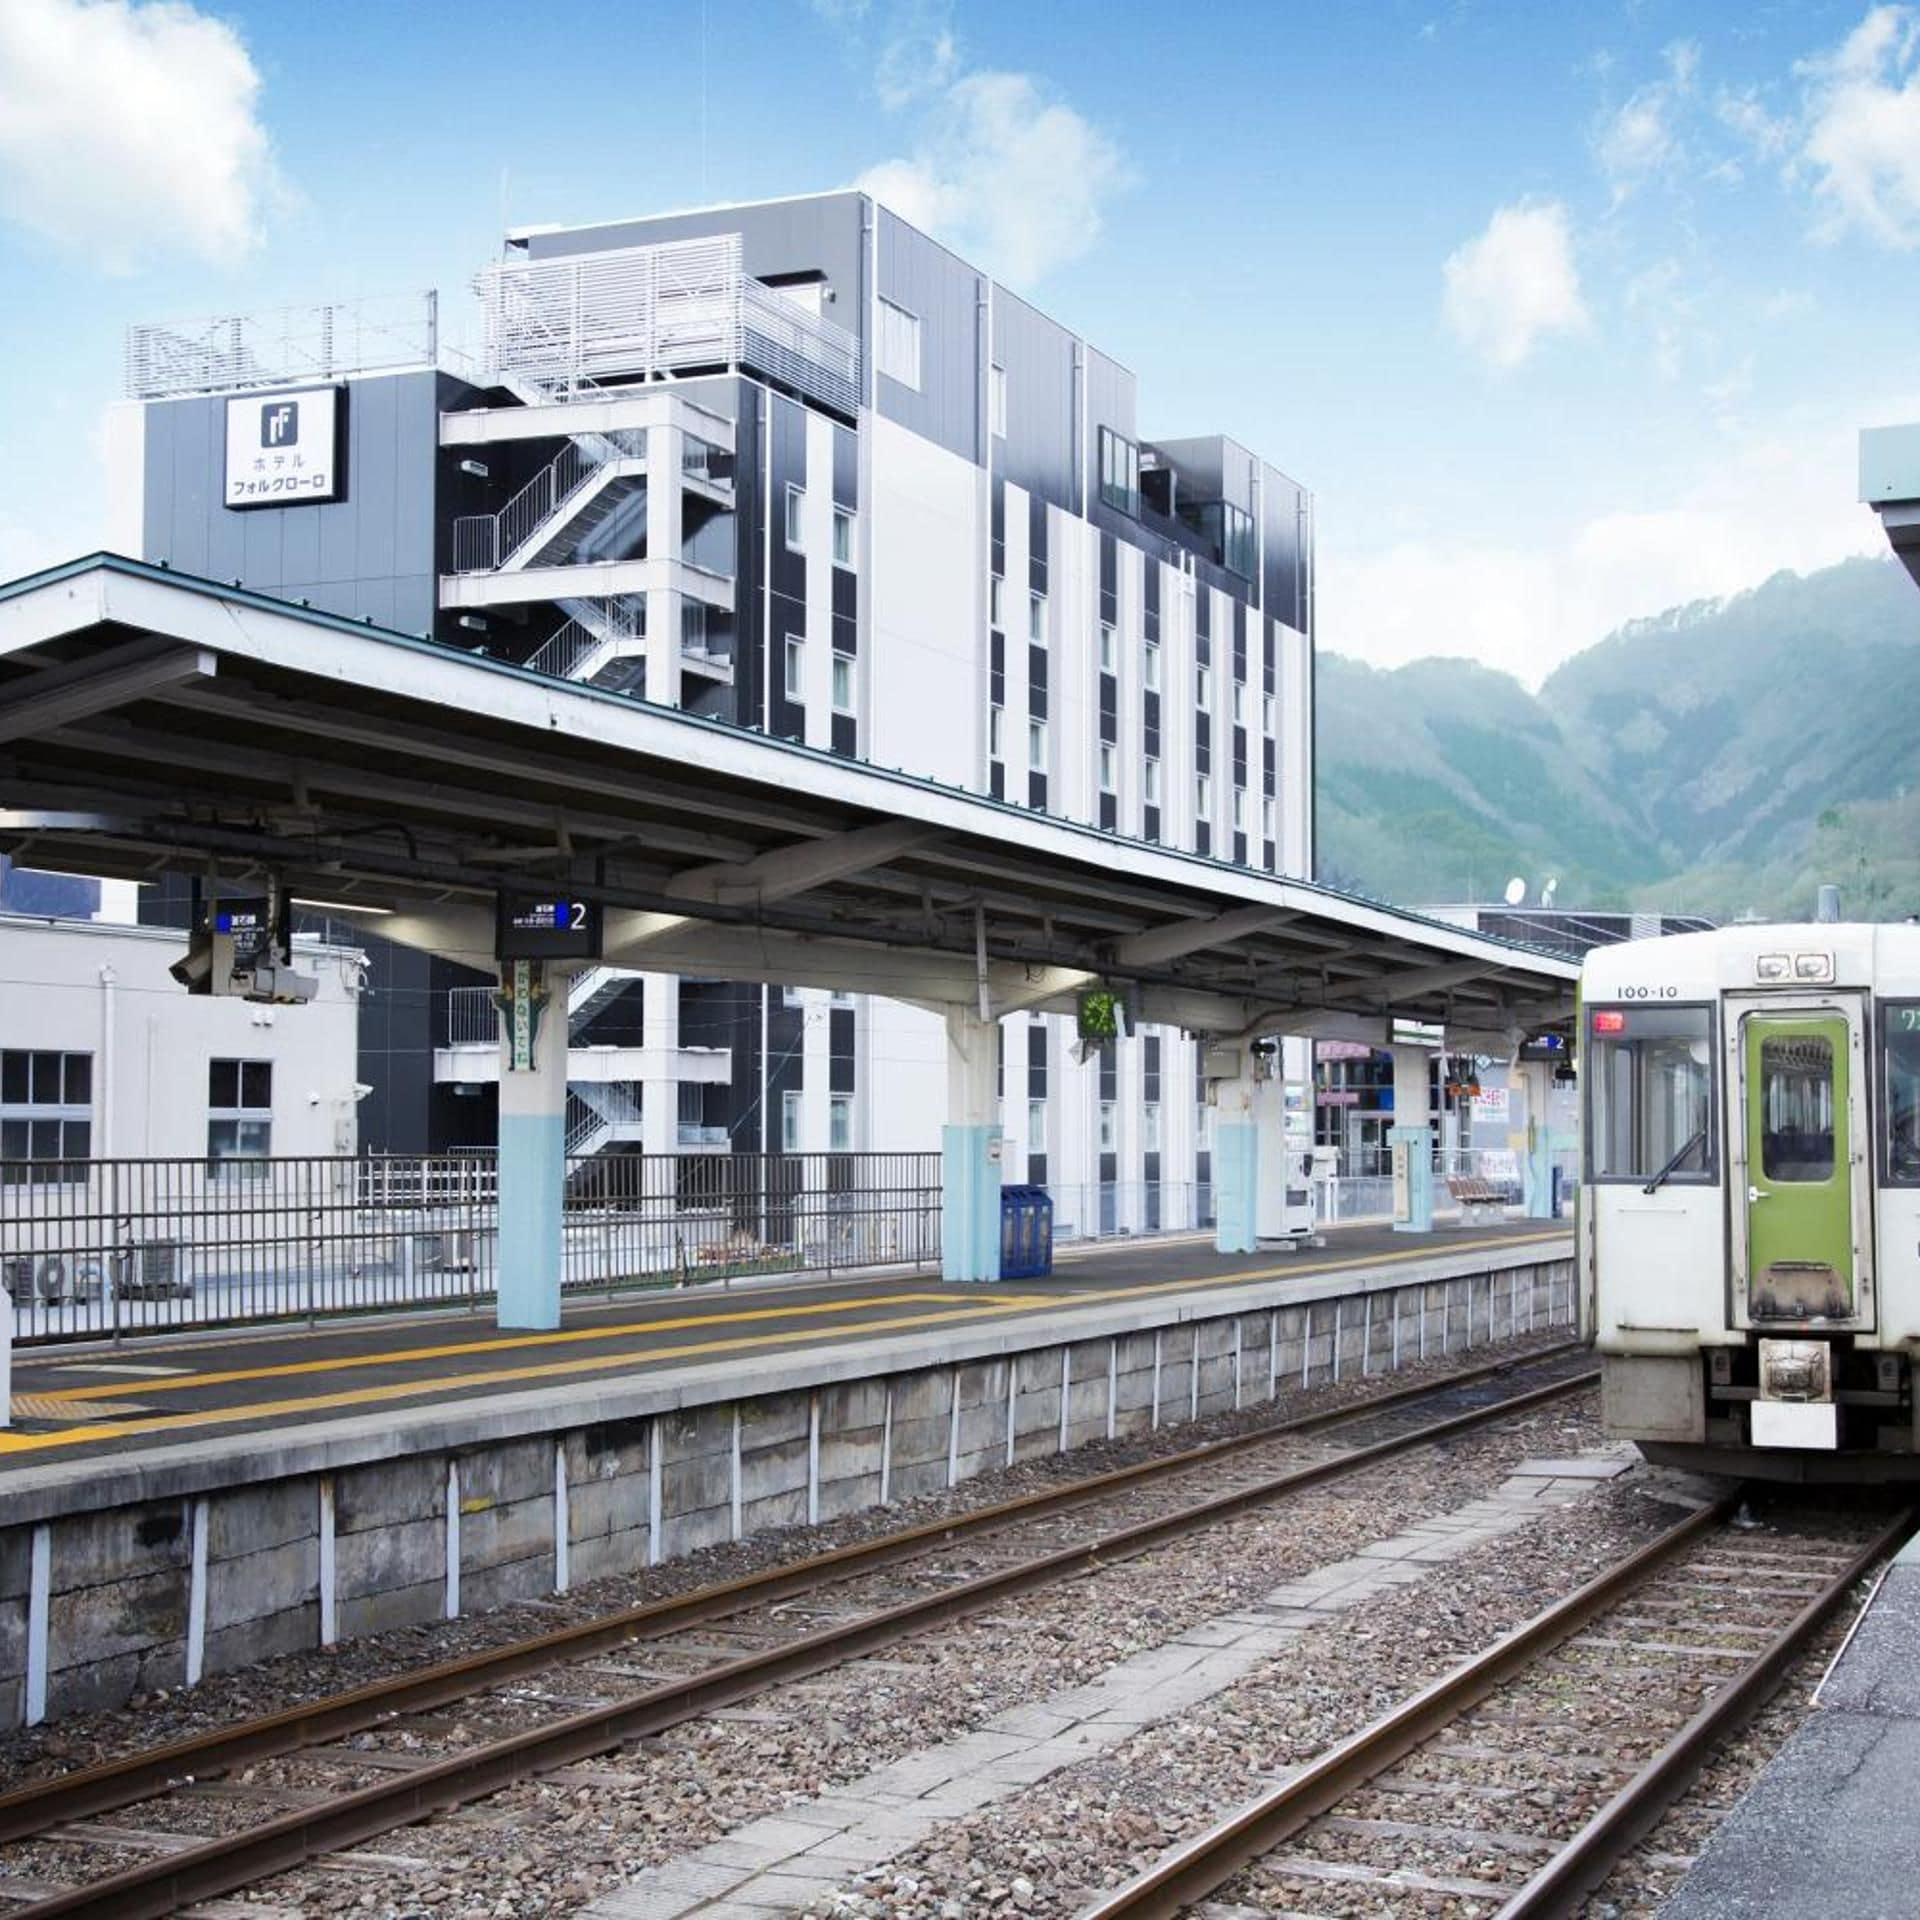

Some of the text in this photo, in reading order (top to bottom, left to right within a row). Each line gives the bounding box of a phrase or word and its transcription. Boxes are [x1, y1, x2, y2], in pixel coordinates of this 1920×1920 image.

[253, 454, 305, 473] ホテル
[233, 474, 325, 496] フォルクローロ
[570, 903, 586, 930] 2
[1617, 986, 1678, 999] 100-10
[1556, 1036, 1564, 1049] 2
